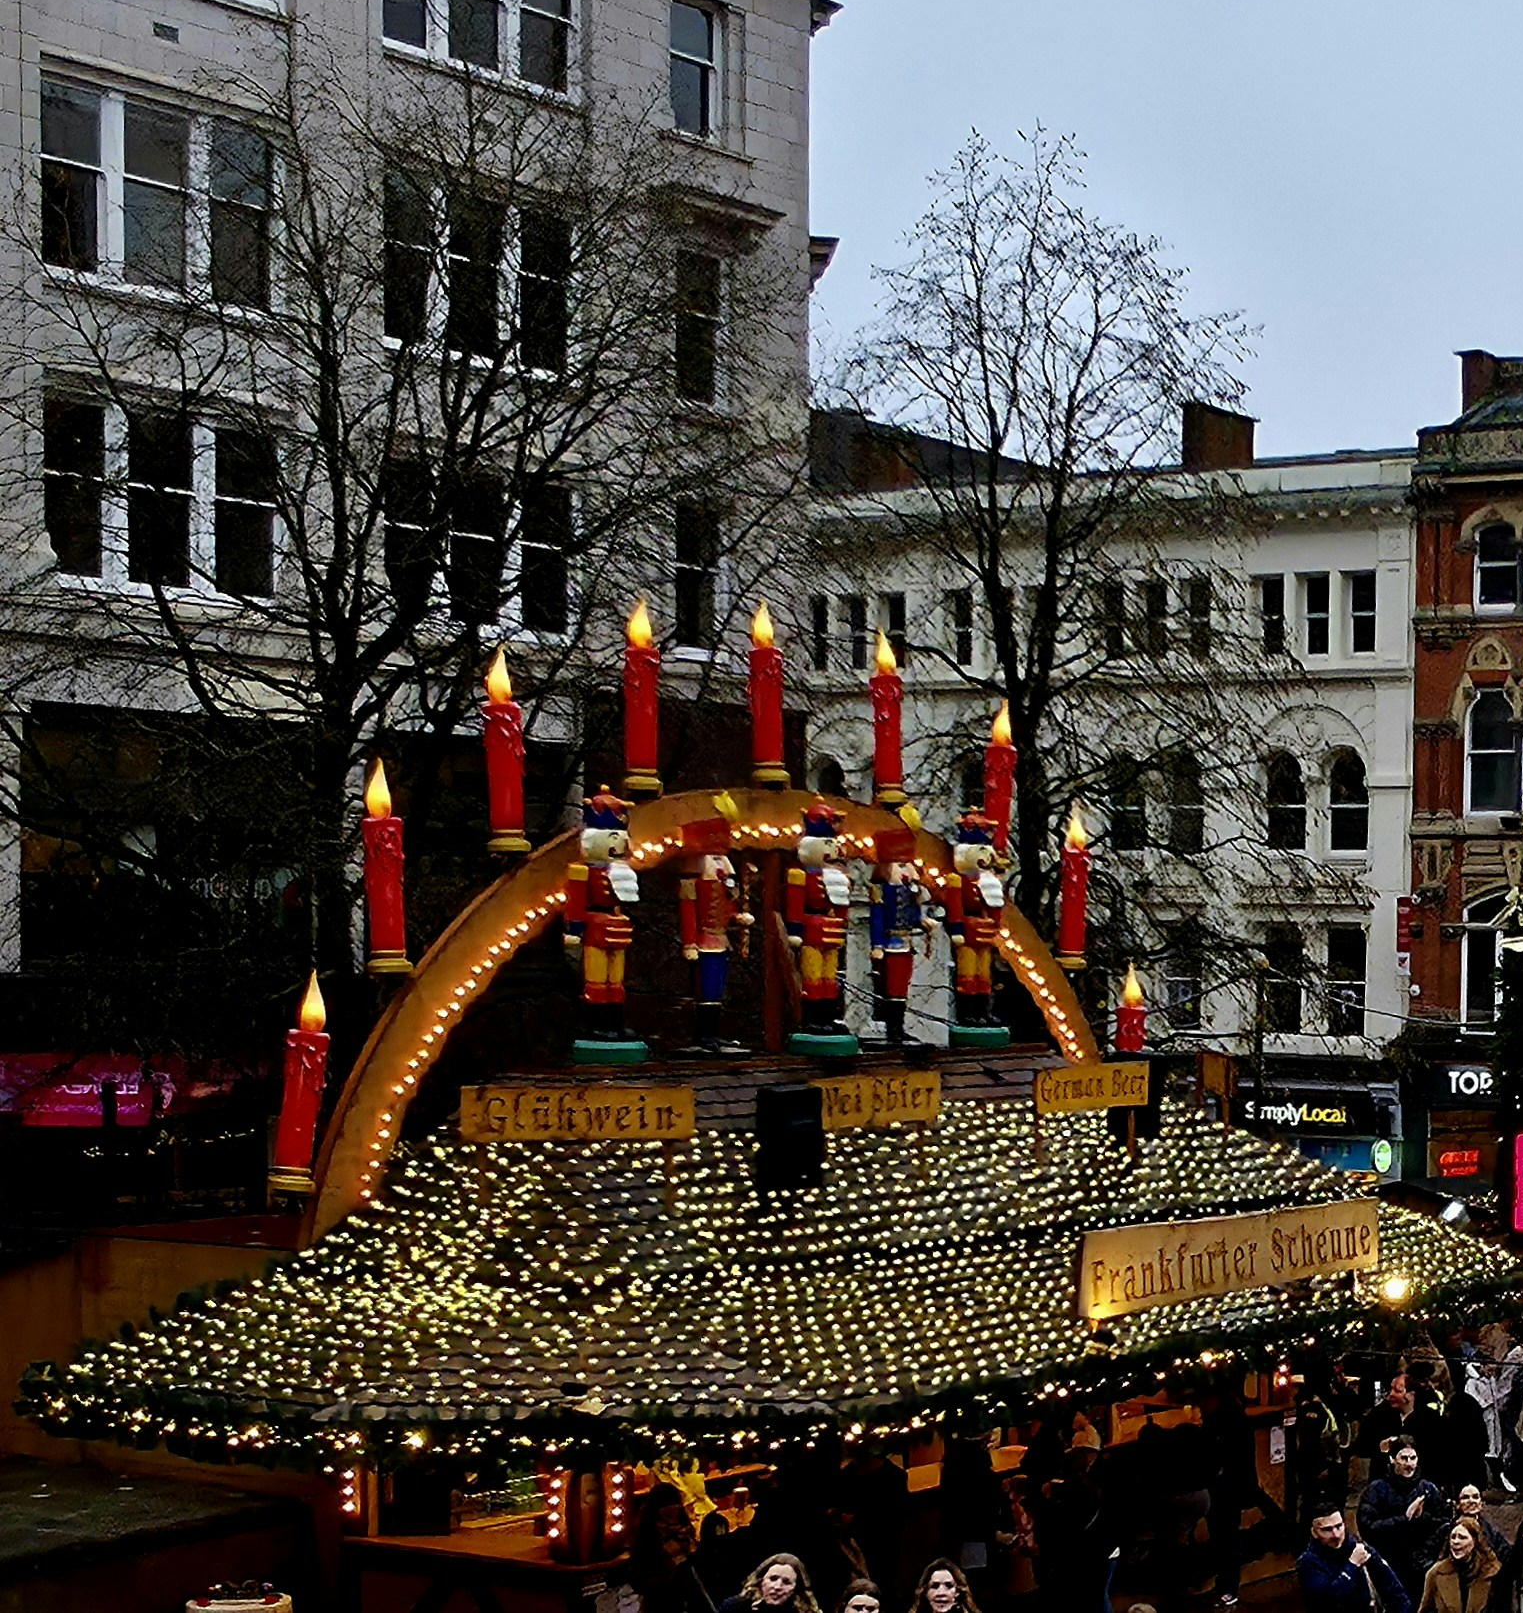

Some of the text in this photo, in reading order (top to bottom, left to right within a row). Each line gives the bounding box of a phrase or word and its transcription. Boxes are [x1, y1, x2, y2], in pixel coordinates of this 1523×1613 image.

[1041, 1069, 1104, 1103] German
[1244, 1101, 1346, 1126] SmplyLocal
[1090, 1238, 1258, 1307] Frankfurter
